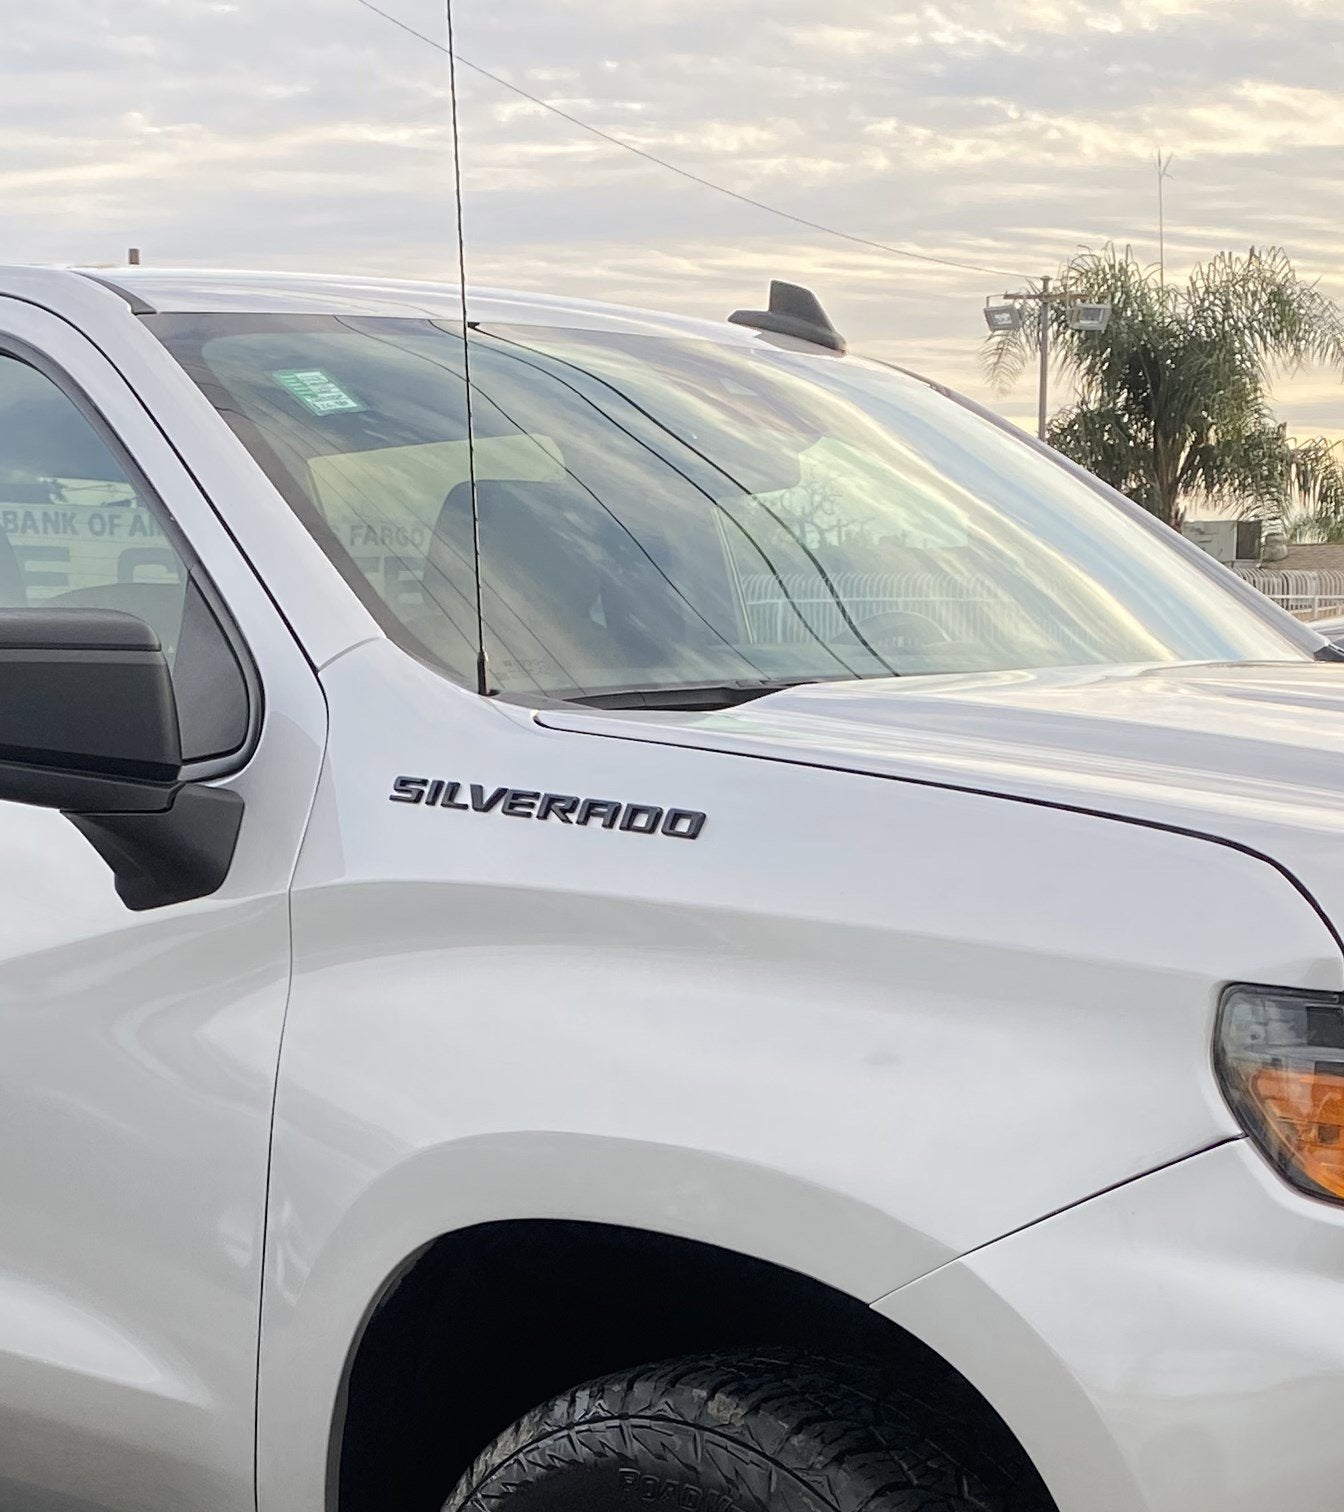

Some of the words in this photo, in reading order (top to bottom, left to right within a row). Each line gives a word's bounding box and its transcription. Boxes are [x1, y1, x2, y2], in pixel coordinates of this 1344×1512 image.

[2, 510, 79, 536] BANK
[88, 513, 123, 538] OF
[350, 524, 425, 547] FARGO
[389, 775, 707, 840] SILVERADO
